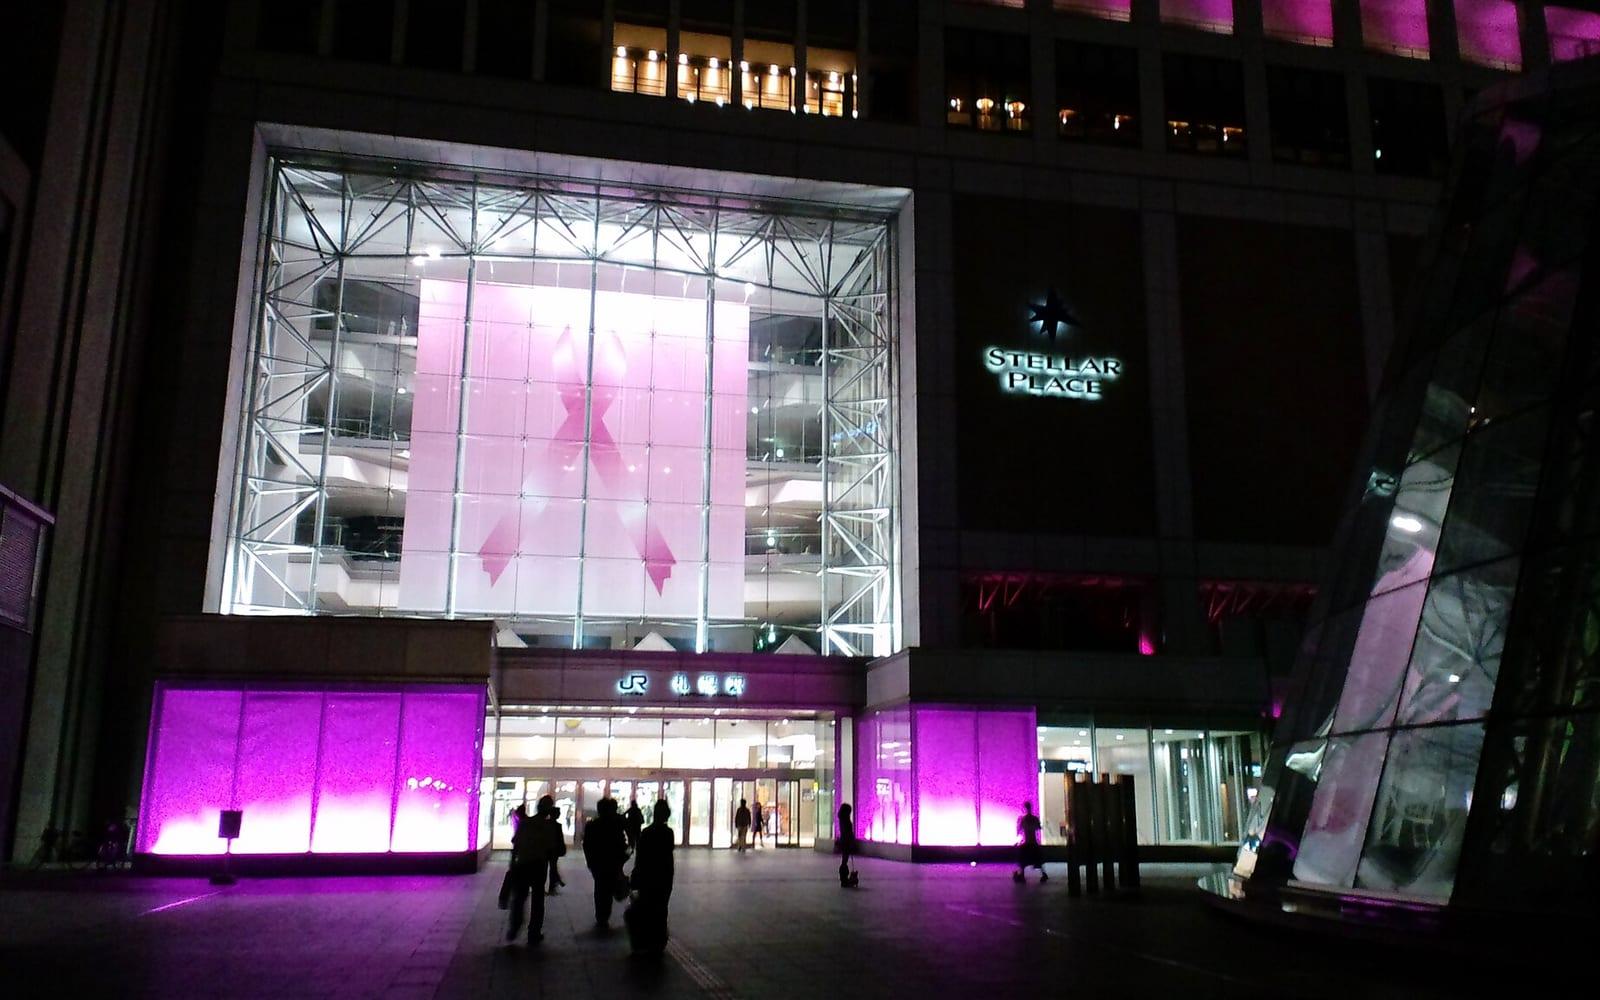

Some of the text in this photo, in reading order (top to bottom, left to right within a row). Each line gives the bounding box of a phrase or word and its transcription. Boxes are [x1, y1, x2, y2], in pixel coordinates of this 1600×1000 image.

[987, 347, 1122, 376] STELLAR
[1007, 371, 1102, 395] PLACE
[619, 674, 648, 691] JR
